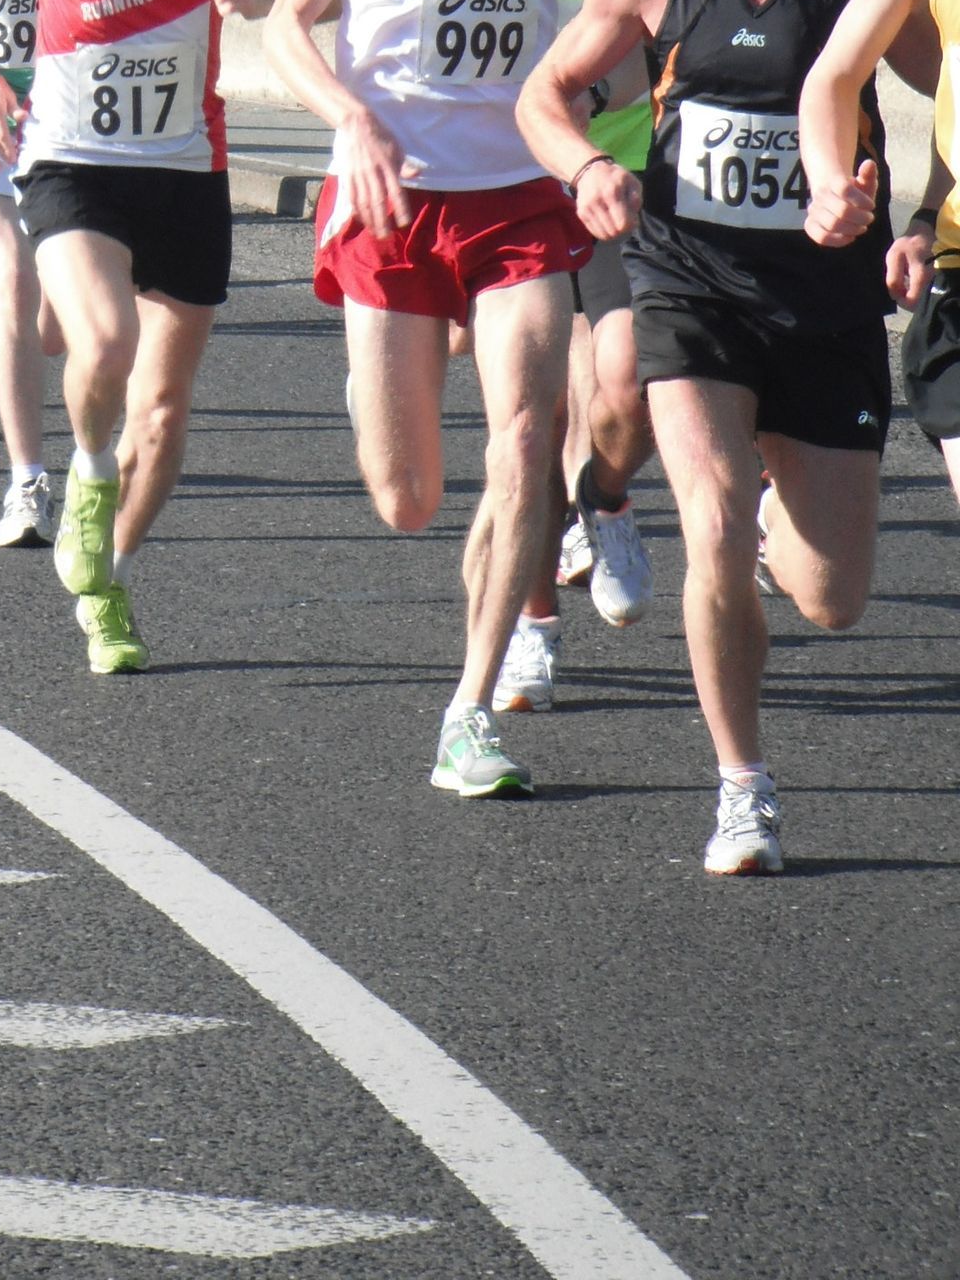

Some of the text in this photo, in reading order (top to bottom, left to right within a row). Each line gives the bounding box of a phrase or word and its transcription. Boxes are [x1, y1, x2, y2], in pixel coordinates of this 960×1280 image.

[120, 56, 178, 78] asics
[436, 20, 524, 79] 999
[91, 81, 179, 137] 817
[696, 151, 812, 210] 1054
